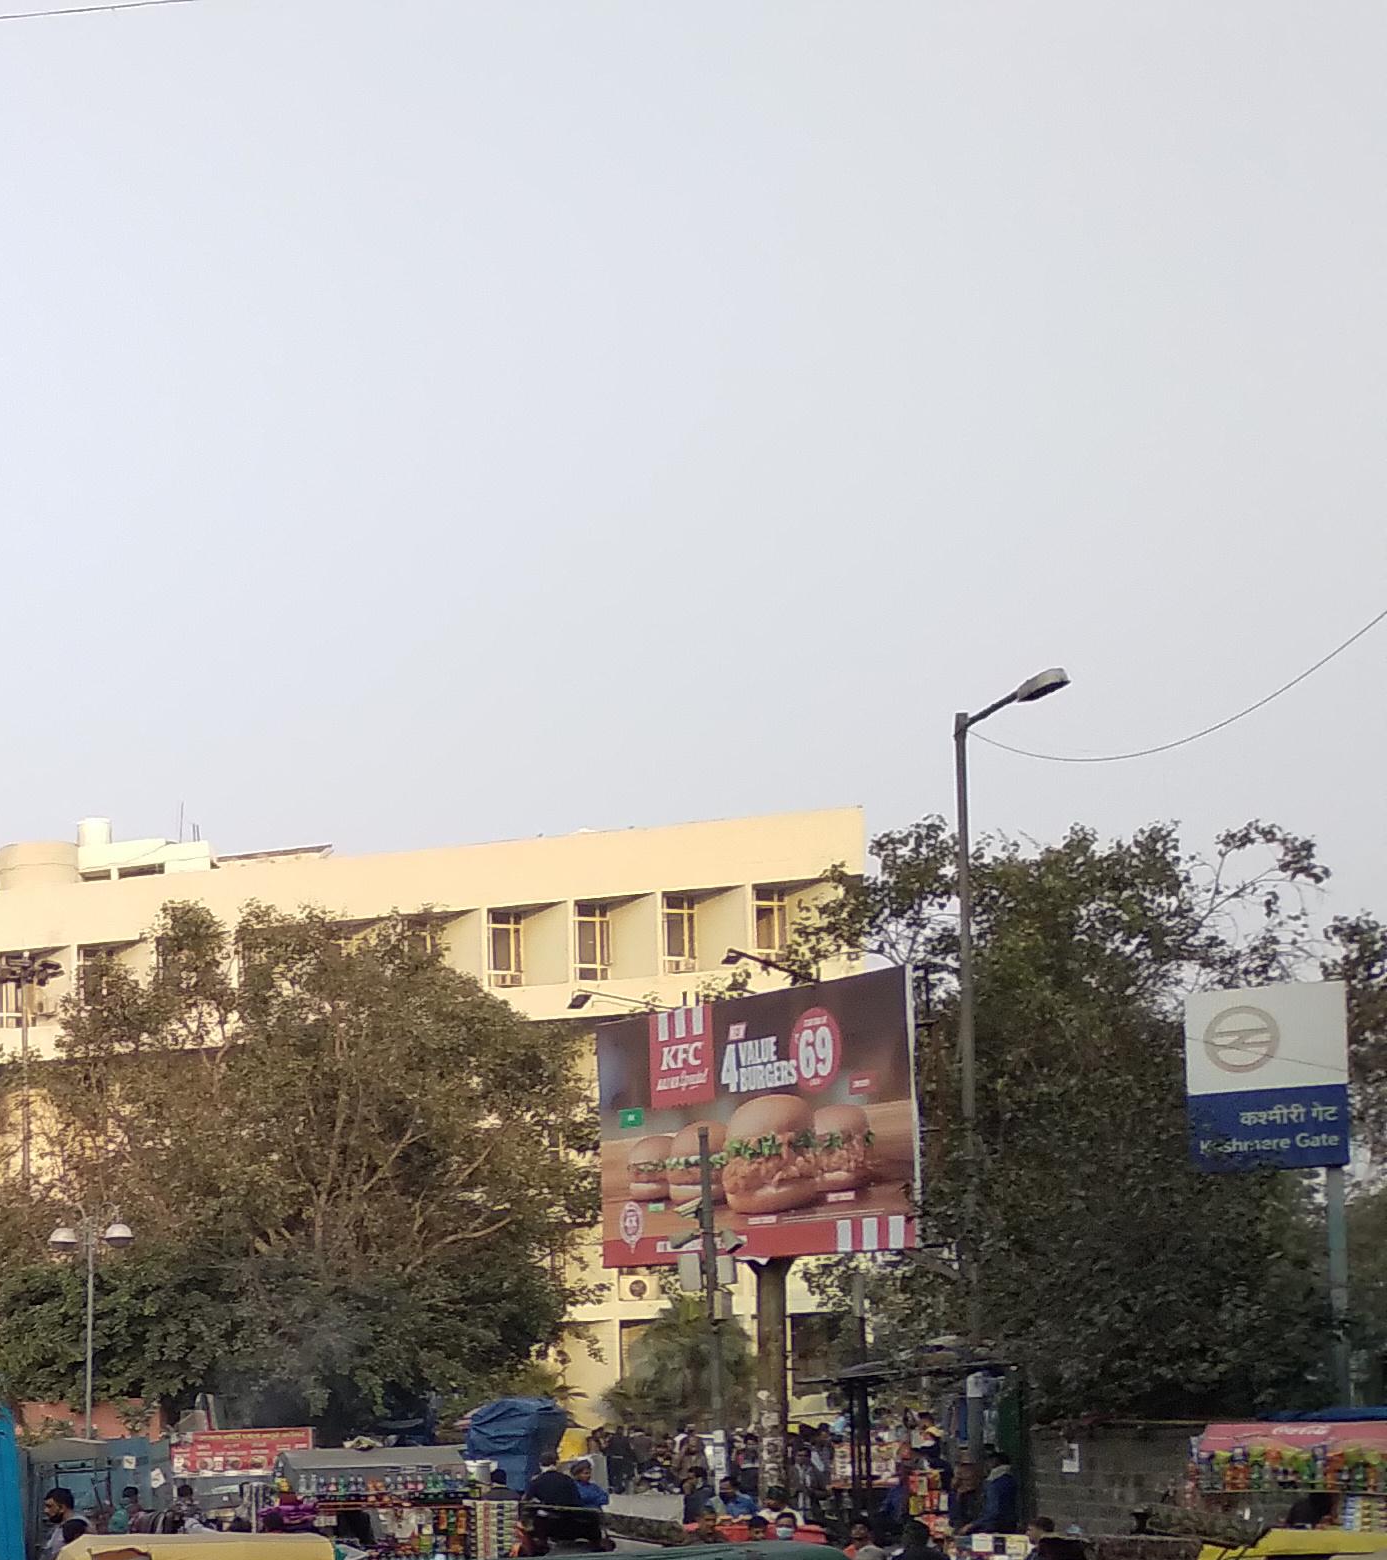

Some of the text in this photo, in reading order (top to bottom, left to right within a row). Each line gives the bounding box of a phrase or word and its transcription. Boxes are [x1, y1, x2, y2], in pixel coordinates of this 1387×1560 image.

[660, 1041, 704, 1071] KFC
[720, 1043, 739, 1093] 4
[738, 1036, 778, 1066] VALUE
[739, 1059, 798, 1093] BURGERS
[1239, 1103, 1338, 1127] कश्मीरी गेट
[1199, 1132, 1339, 1156] Kshmere Gate
